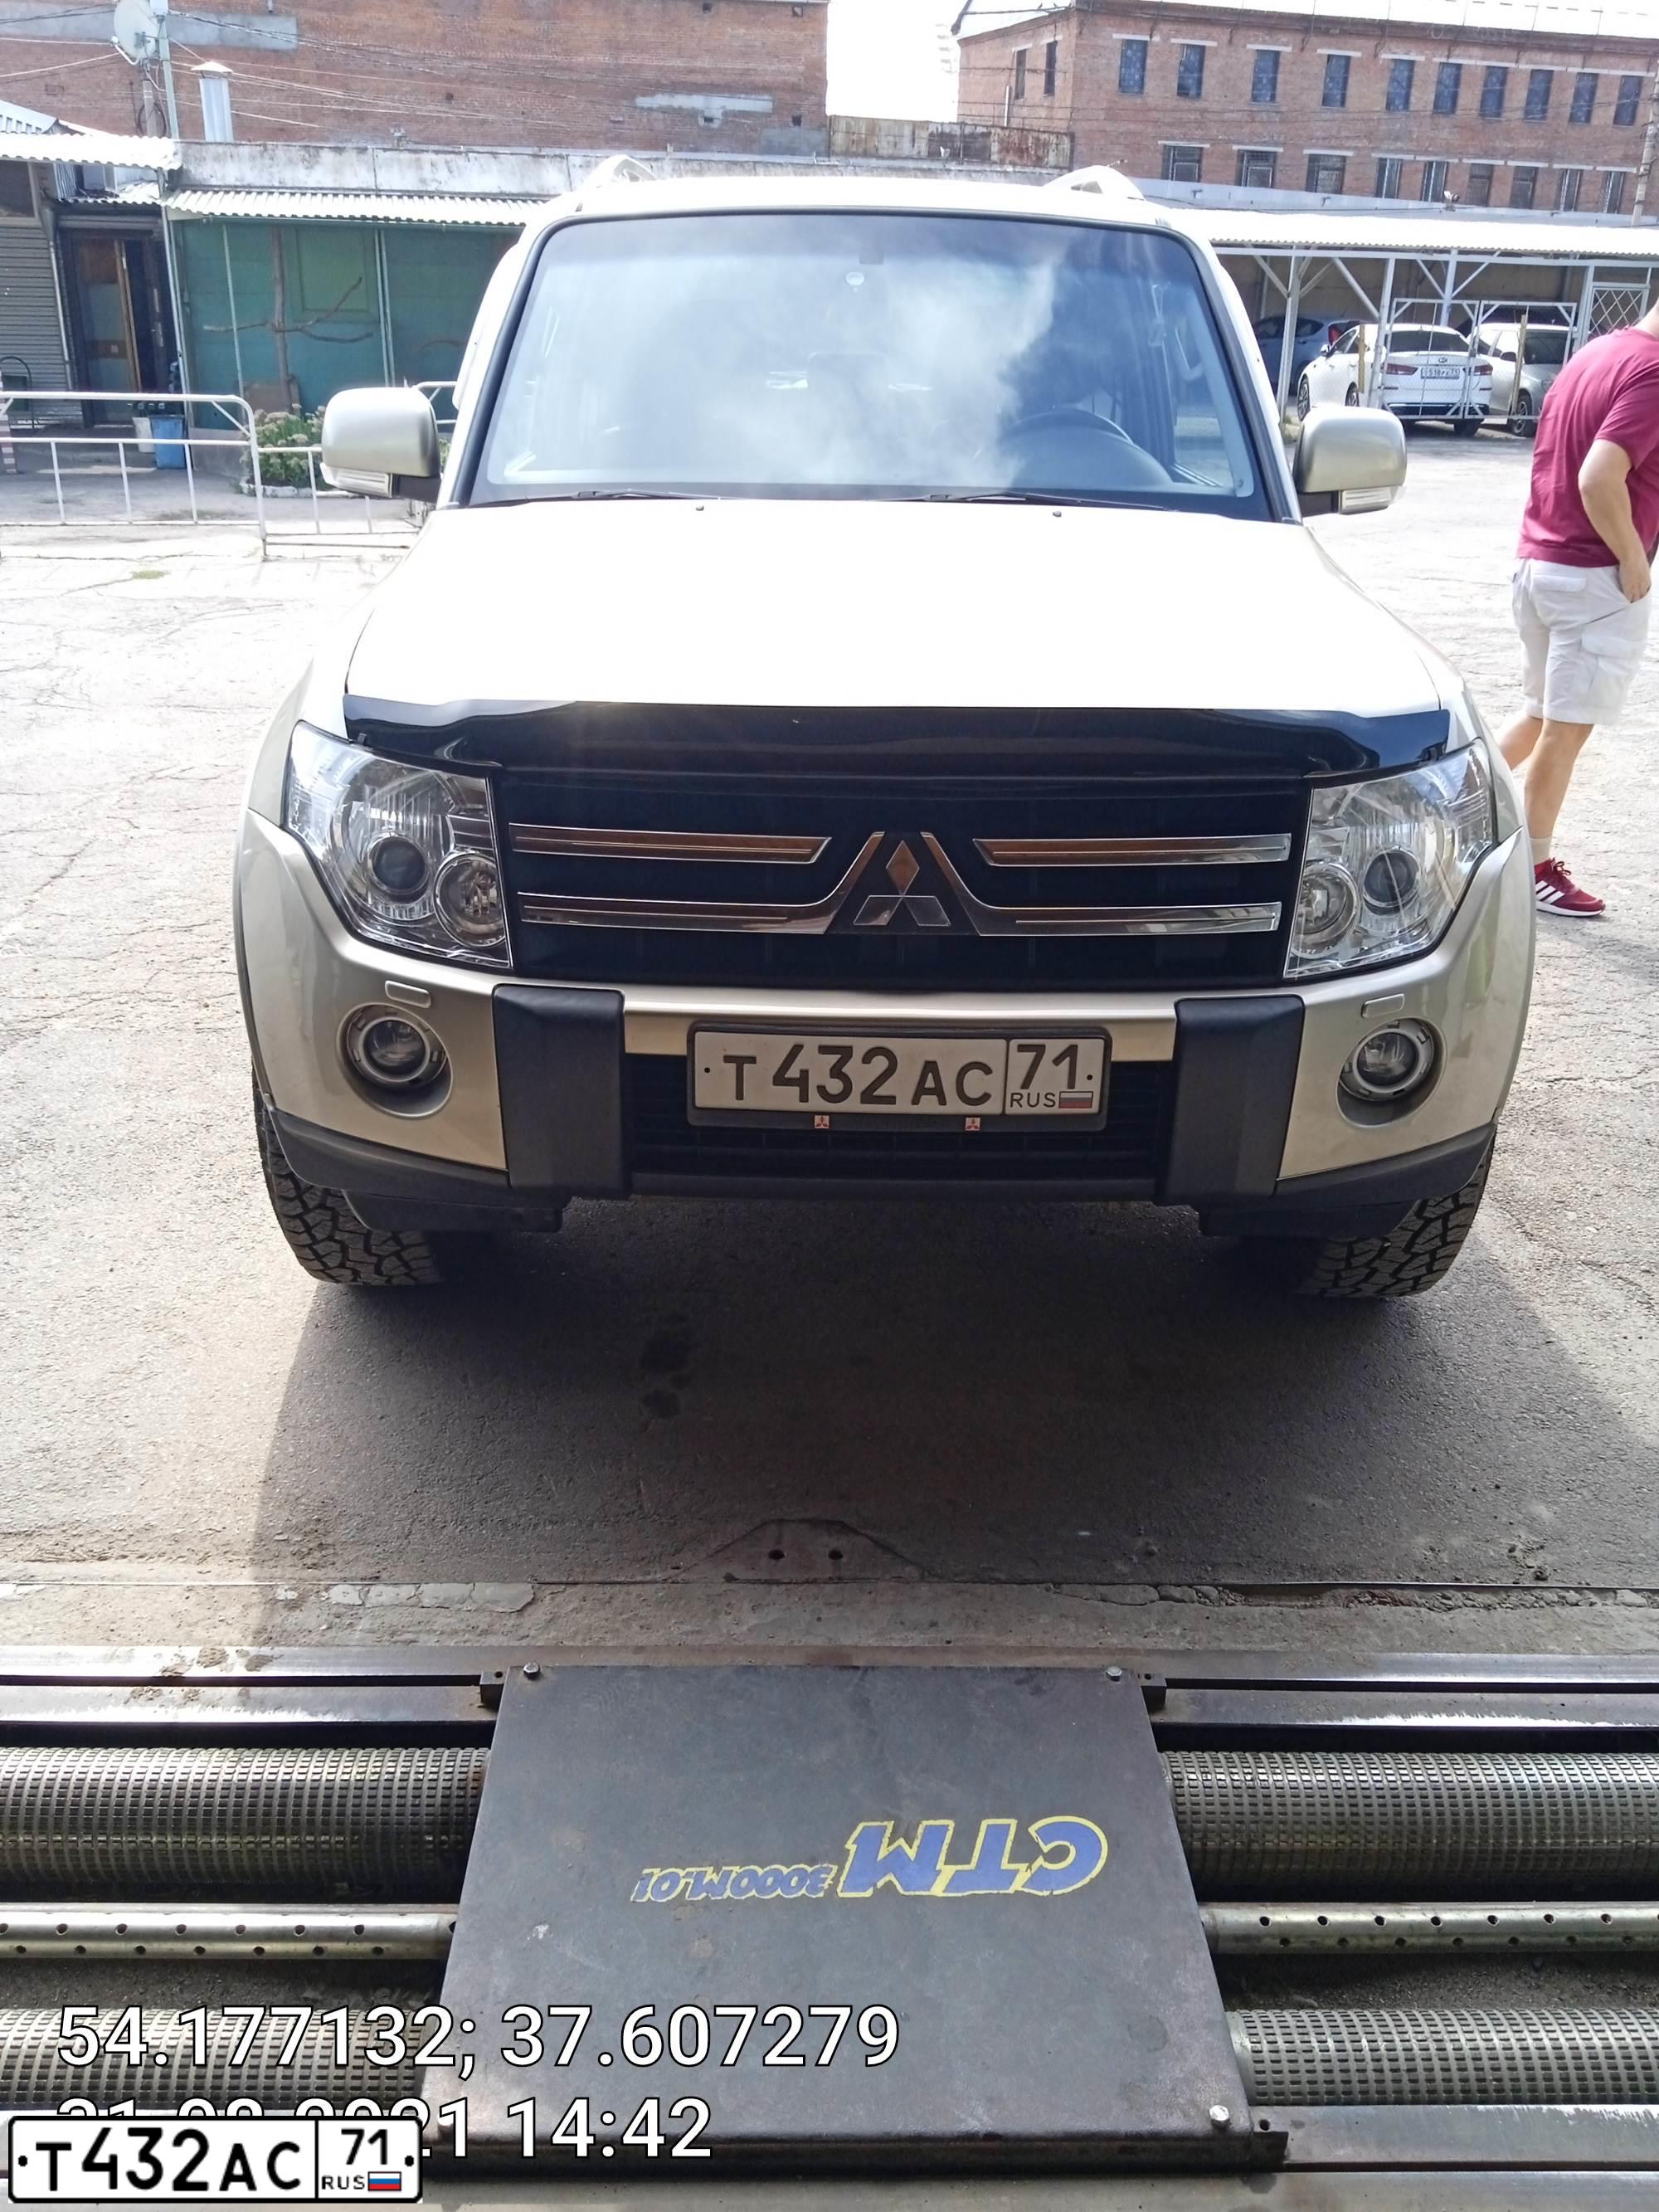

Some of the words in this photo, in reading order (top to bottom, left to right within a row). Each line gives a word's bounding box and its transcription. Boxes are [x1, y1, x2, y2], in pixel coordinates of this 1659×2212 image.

[1017, 1044, 1079, 1089] 71
[1010, 1091, 1057, 1108] RUS
[838, 1815, 1108, 1898] СТМ
